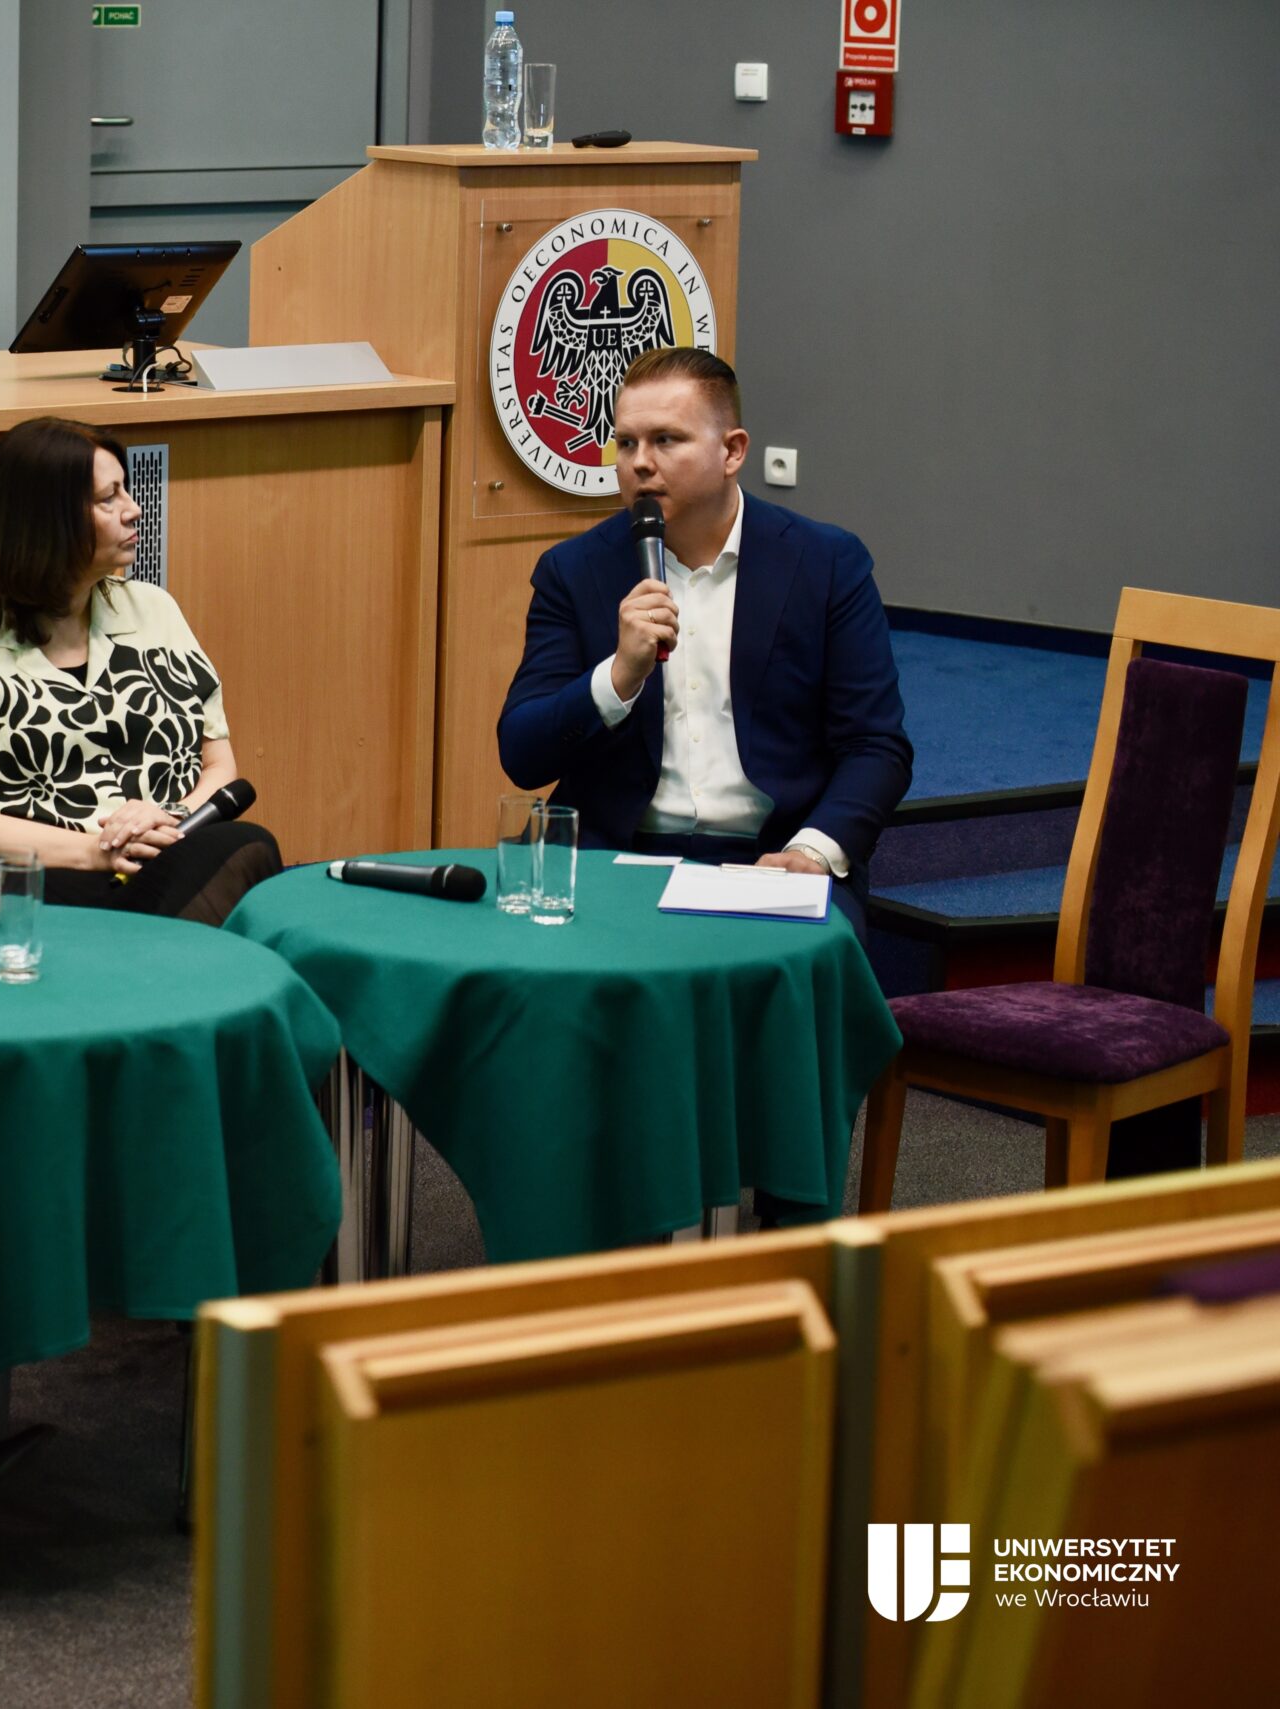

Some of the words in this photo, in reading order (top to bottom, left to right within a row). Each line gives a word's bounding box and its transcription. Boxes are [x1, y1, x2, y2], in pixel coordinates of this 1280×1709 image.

[511, 217, 669, 303] OECONOMICA
[678, 262, 700, 296] IN
[591, 328, 618, 346] UE
[496, 323, 587, 488] UNIVERSITAS
